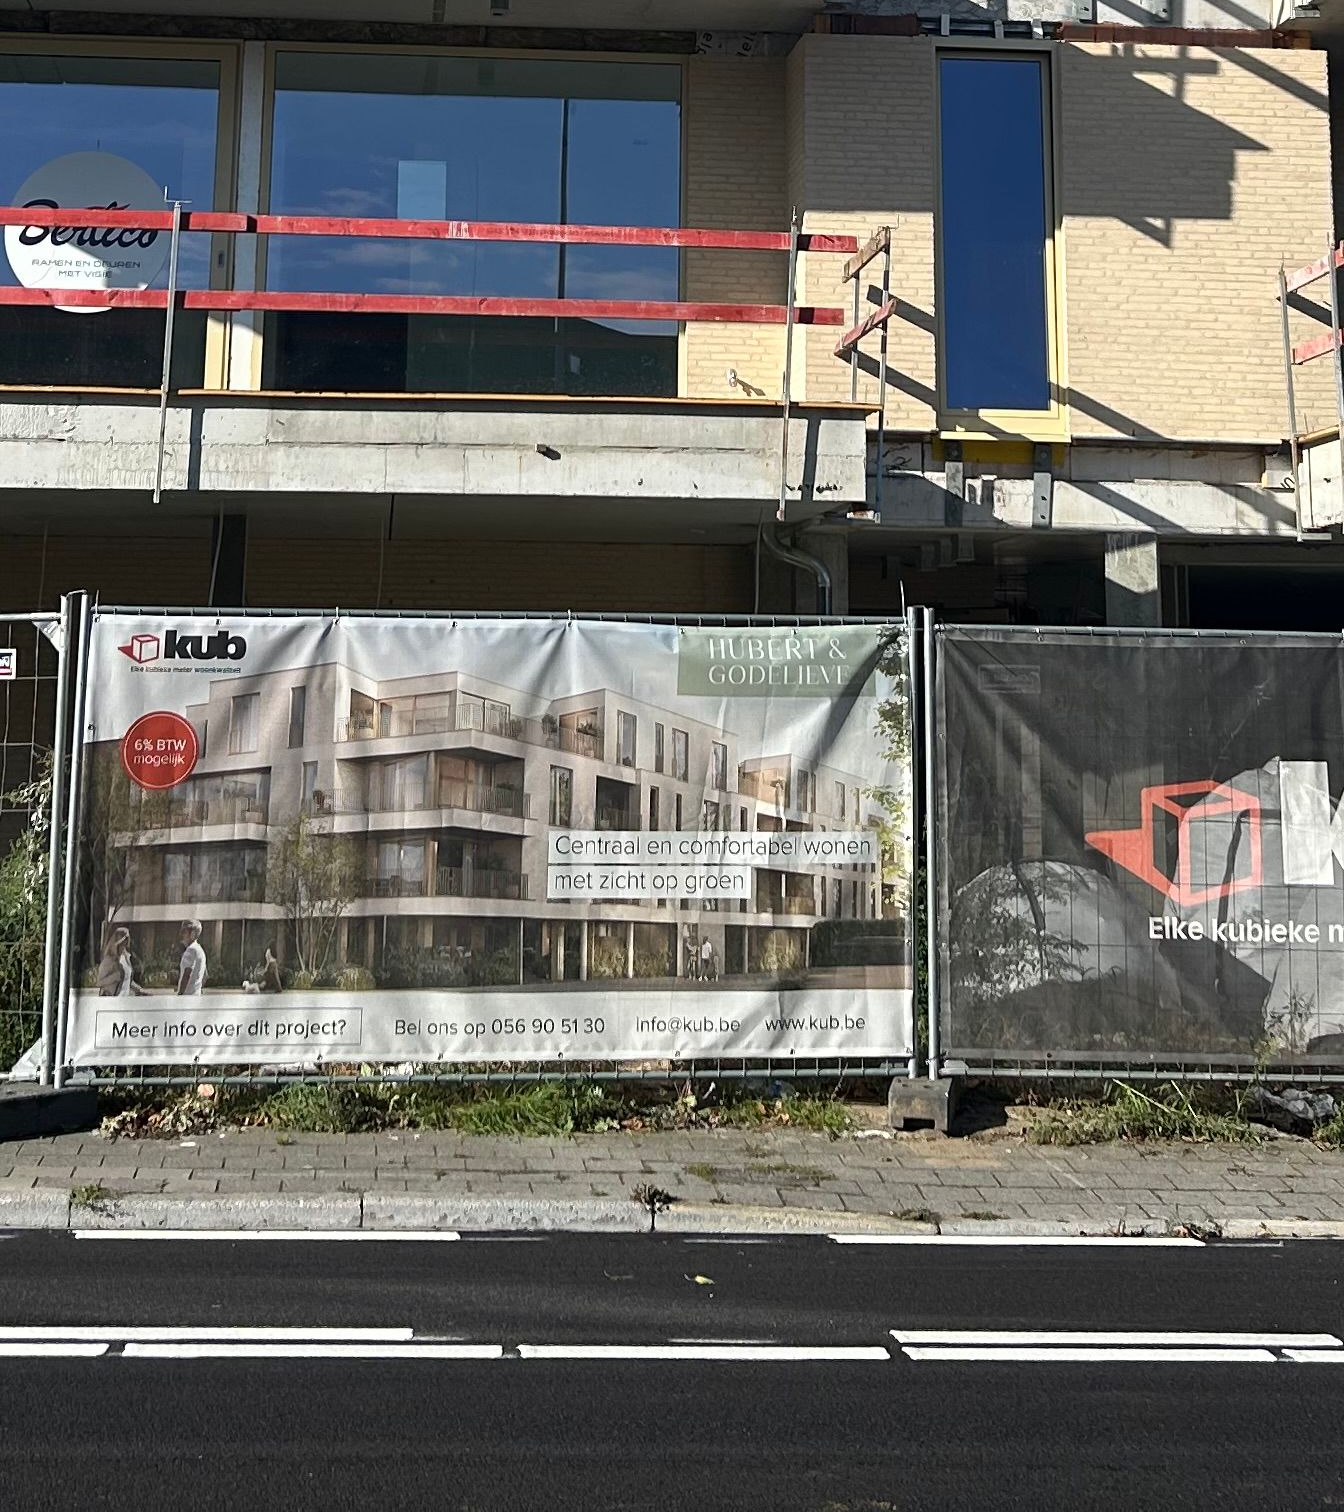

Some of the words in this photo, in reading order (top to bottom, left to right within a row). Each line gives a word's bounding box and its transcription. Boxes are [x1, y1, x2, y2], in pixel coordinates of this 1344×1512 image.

[164, 629, 247, 660] kub
[709, 638, 820, 660] HUBERT
[829, 638, 848, 660] &
[709, 664, 851, 686] GODELIEVE
[134, 739, 154, 751] 6%
[156, 739, 187, 751] BTW
[133, 754, 185, 767] mogelijk
[555, 835, 640, 855] Centraal
[647, 840, 672, 855] en
[679, 835, 797, 855] comfortabel
[803, 840, 871, 855] wonen
[555, 872, 592, 890] met
[600, 871, 646, 890] zicht
[653, 875, 678, 894] op
[685, 874, 744, 893] groen
[1149, 916, 1204, 940] Elke
[1211, 918, 1320, 942] kubieke
[112, 1022, 158, 1039] Meer
[202, 1024, 243, 1037] over
[247, 1020, 270, 1036] dit
[275, 1019, 347, 1041] project?
[395, 1019, 422, 1036] Bel
[427, 1022, 458, 1036] ons
[464, 1022, 487, 1040] op
[491, 1018, 526, 1035] 056
[532, 1018, 556, 1035] 90
[560, 1018, 579, 1035] 51
[583, 1018, 605, 1035] 30
[765, 1015, 866, 1032] www.kub.be
